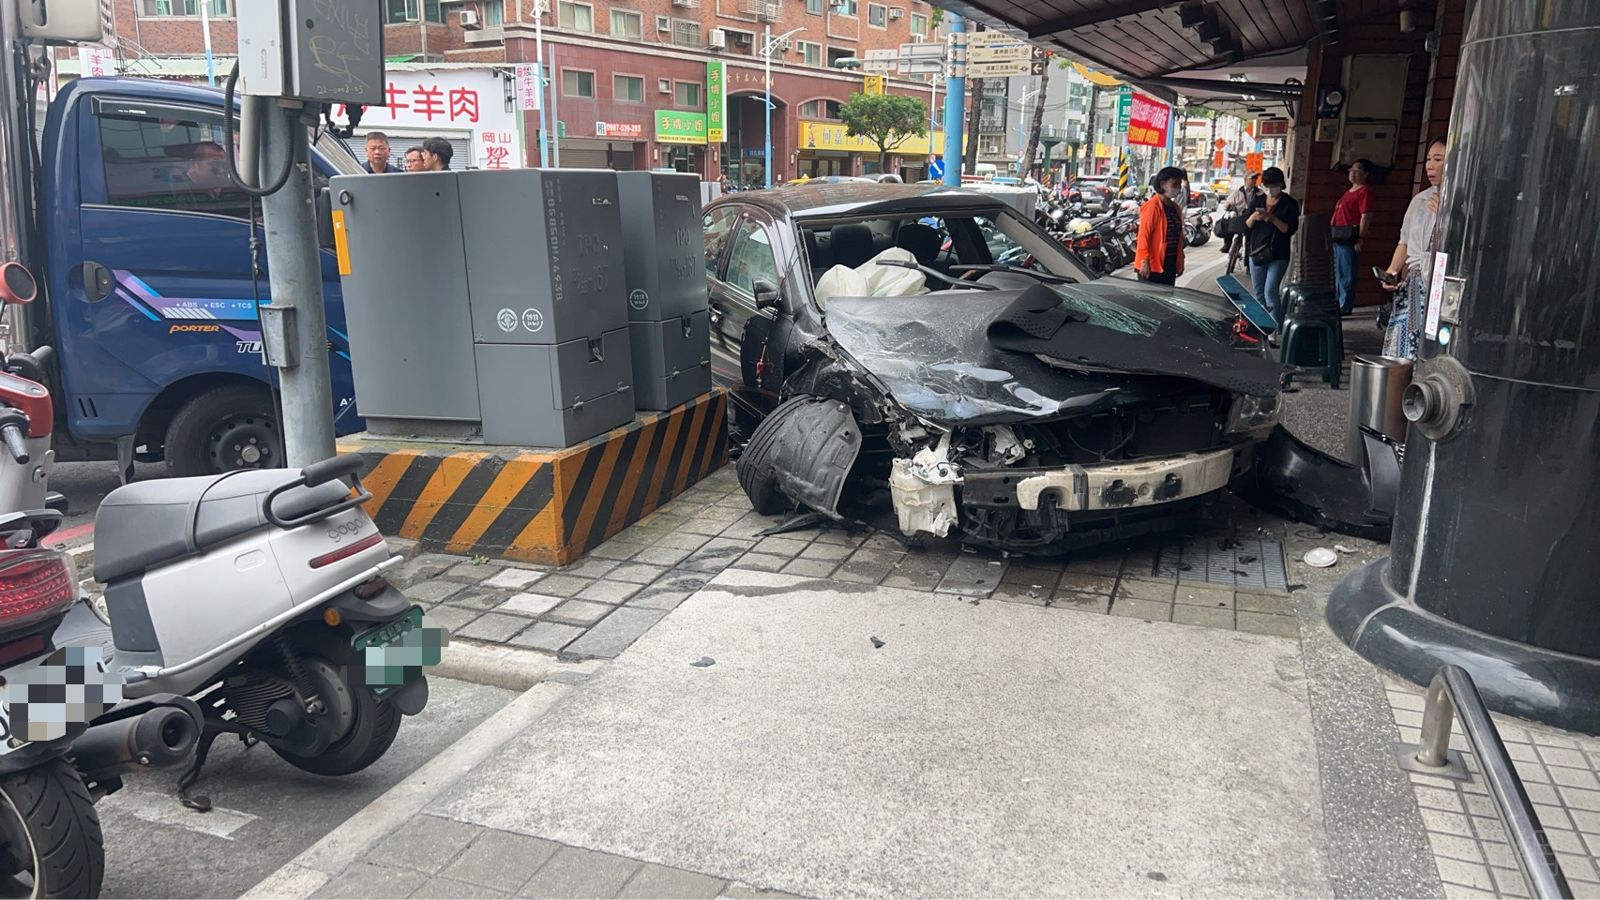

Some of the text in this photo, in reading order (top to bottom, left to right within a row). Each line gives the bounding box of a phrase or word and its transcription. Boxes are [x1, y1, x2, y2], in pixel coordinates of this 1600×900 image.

[337, 82, 480, 123] 牛羊肉
[482, 132, 511, 143] 岡山
